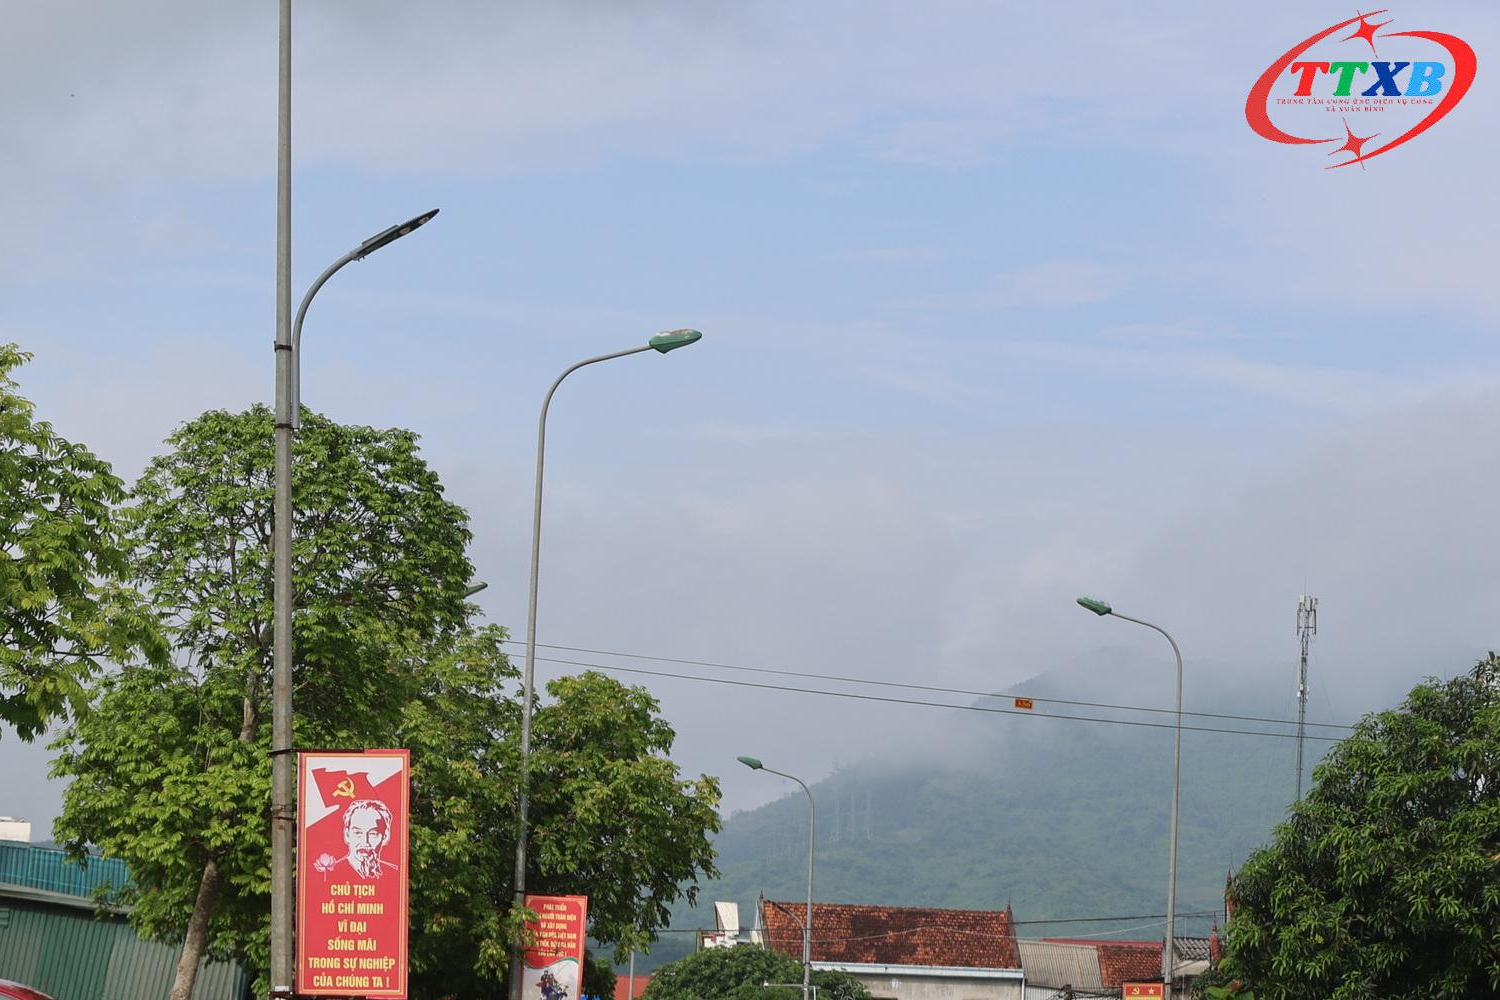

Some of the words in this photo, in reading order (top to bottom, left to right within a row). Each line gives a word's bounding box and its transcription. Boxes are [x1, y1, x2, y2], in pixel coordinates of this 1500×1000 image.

[330, 881, 350, 896] CHỦ
[353, 884, 375, 898] TỊCH
[338, 901, 354, 914] CHÍ
[357, 903, 384, 914] MINH
[338, 919, 348, 932] VĨ
[350, 921, 366, 935] ĐẠI
[327, 935, 354, 950] SỐNG
[358, 937, 376, 951] MÃI
[308, 958, 340, 968] TRONG
[343, 957, 358, 972] SỰ
[359, 956, 395, 972] NGHIỆP
[313, 972, 333, 987] CỦA
[336, 974, 369, 987] CHÚNG
[372, 976, 383, 987] TA
[386, 976, 389, 987] !
